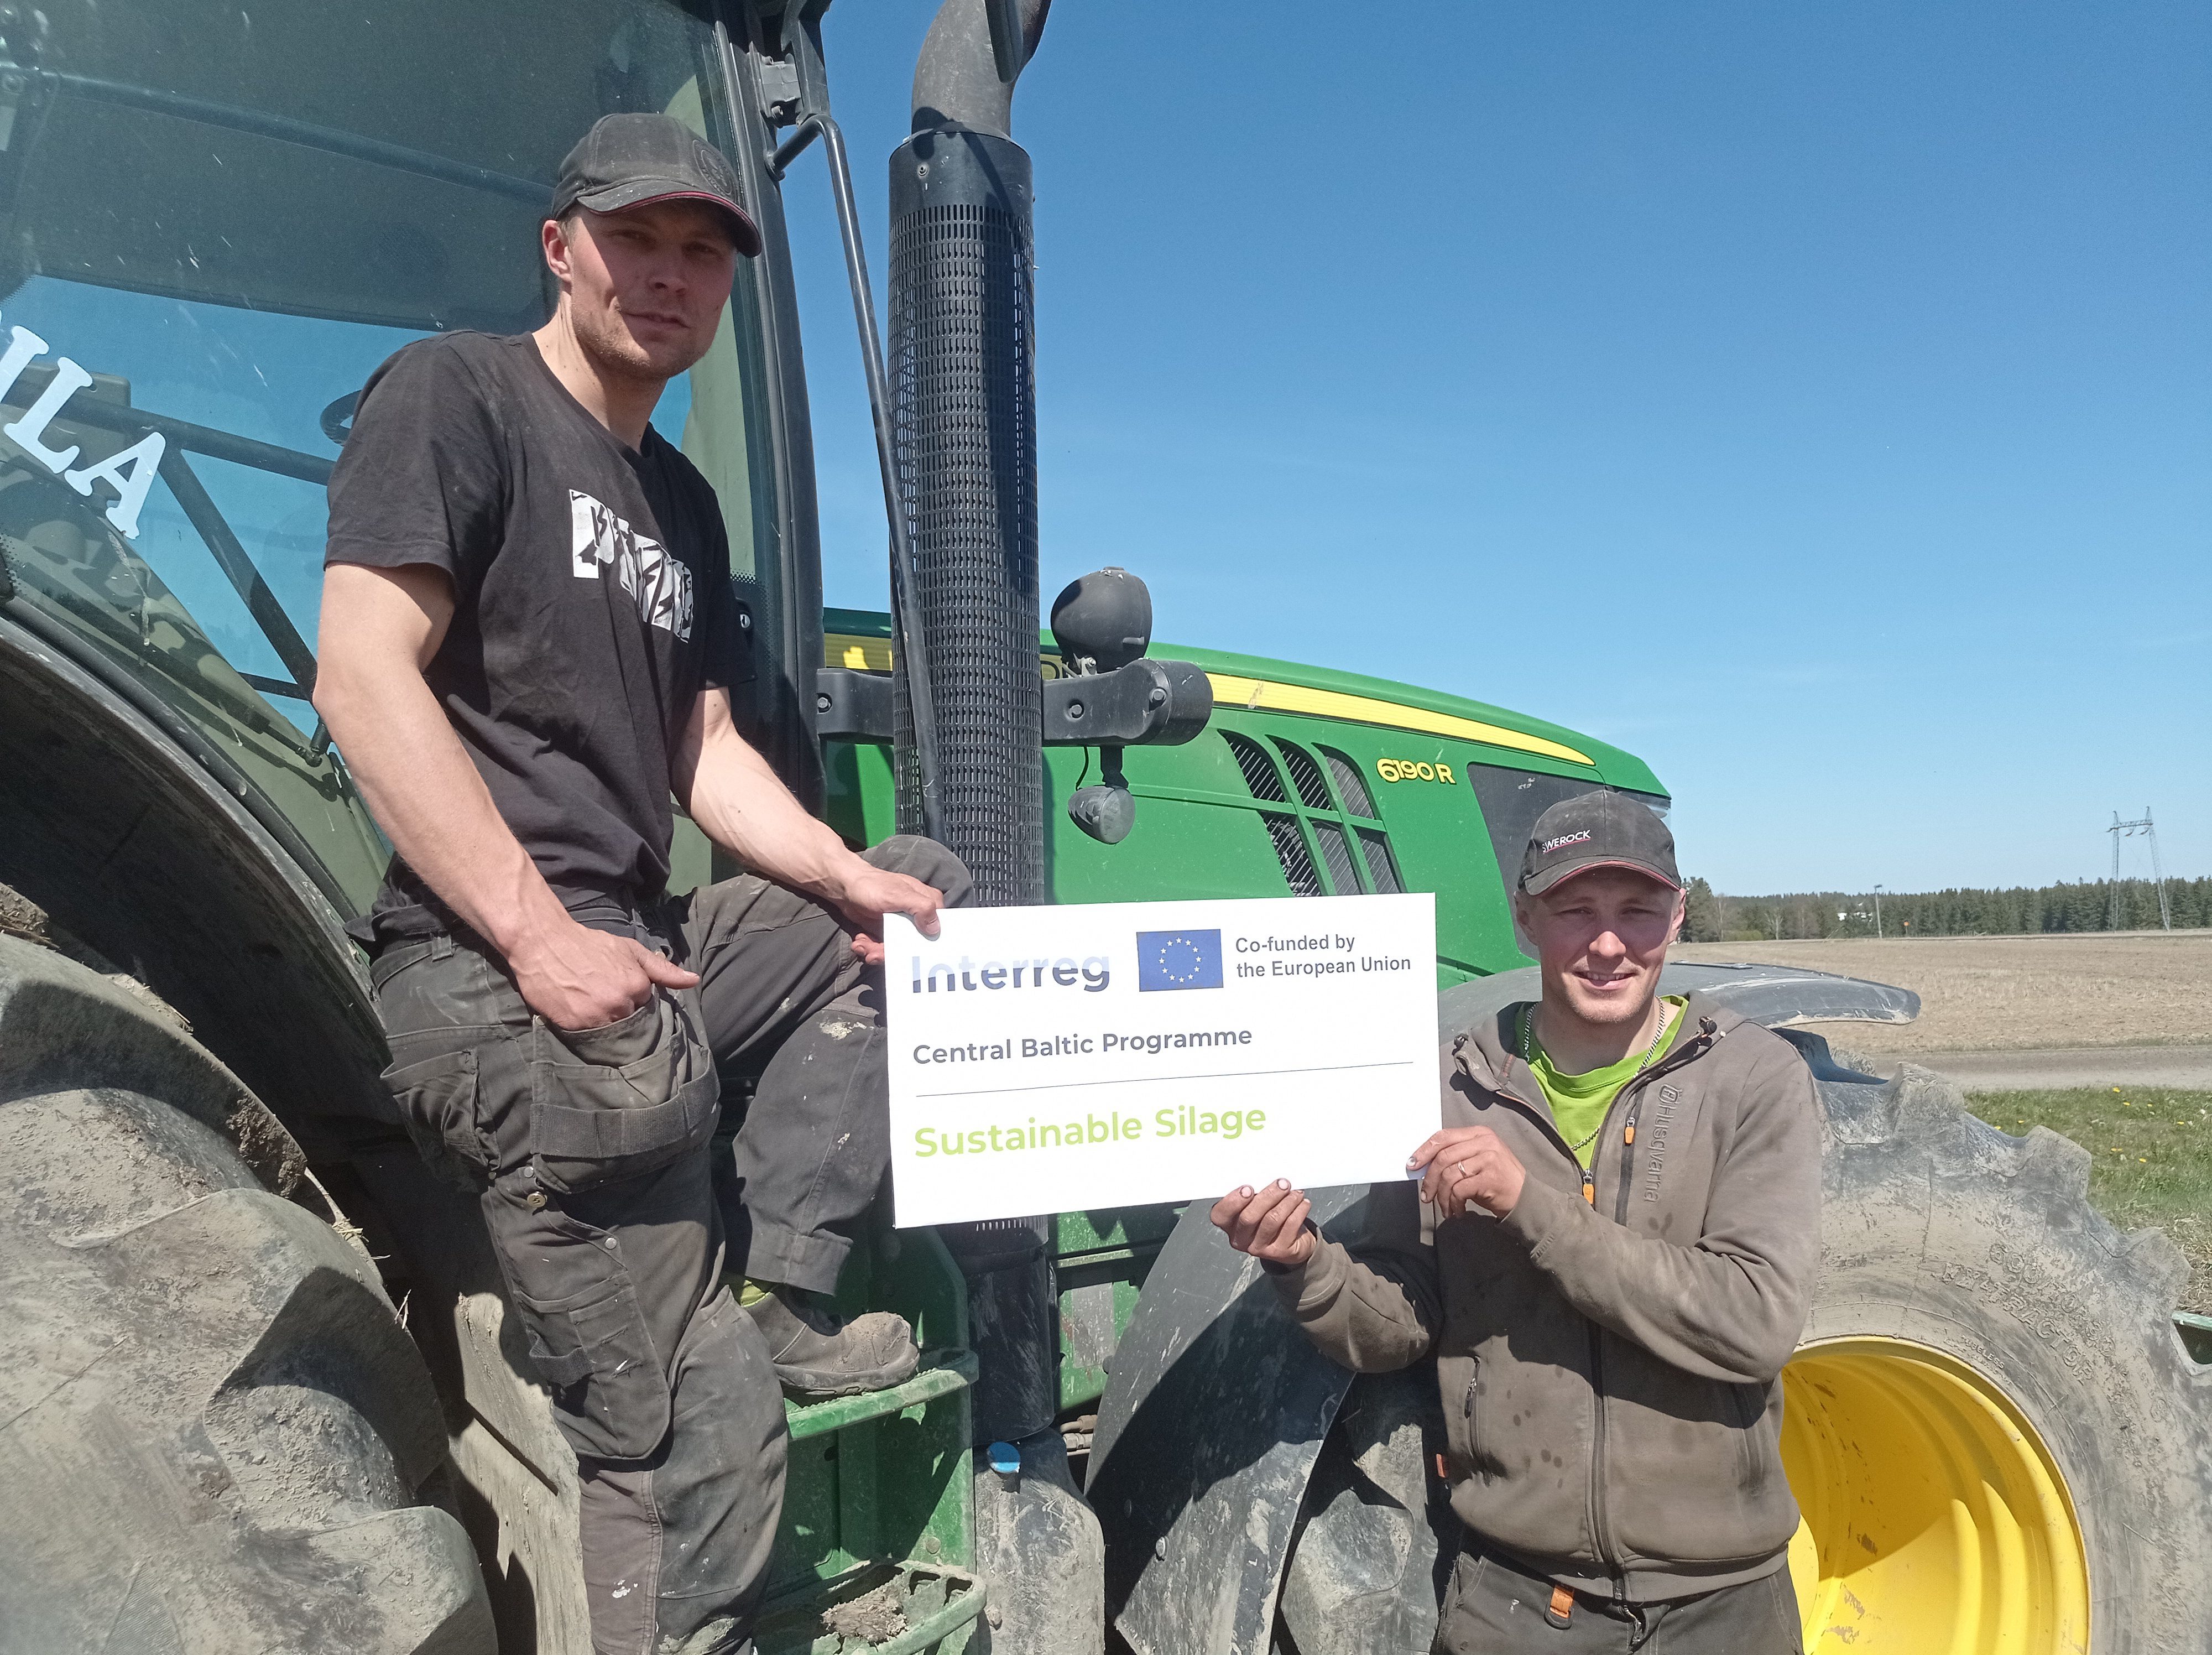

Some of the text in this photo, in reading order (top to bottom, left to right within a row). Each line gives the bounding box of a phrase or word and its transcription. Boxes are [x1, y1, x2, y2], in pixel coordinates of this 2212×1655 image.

[0, 310, 166, 540] ILA
[1542, 829, 1592, 853] SWEROCK
[1236, 934, 1355, 954] Co-funded by
[912, 956, 1110, 994] Interreg
[1237, 956, 1411, 979] the European Union
[914, 1029, 1253, 1065] Central Baltic Programme
[915, 1105, 1267, 1158] Sustainable Silage
[1643, 1104, 1677, 1203] Husqvarna
